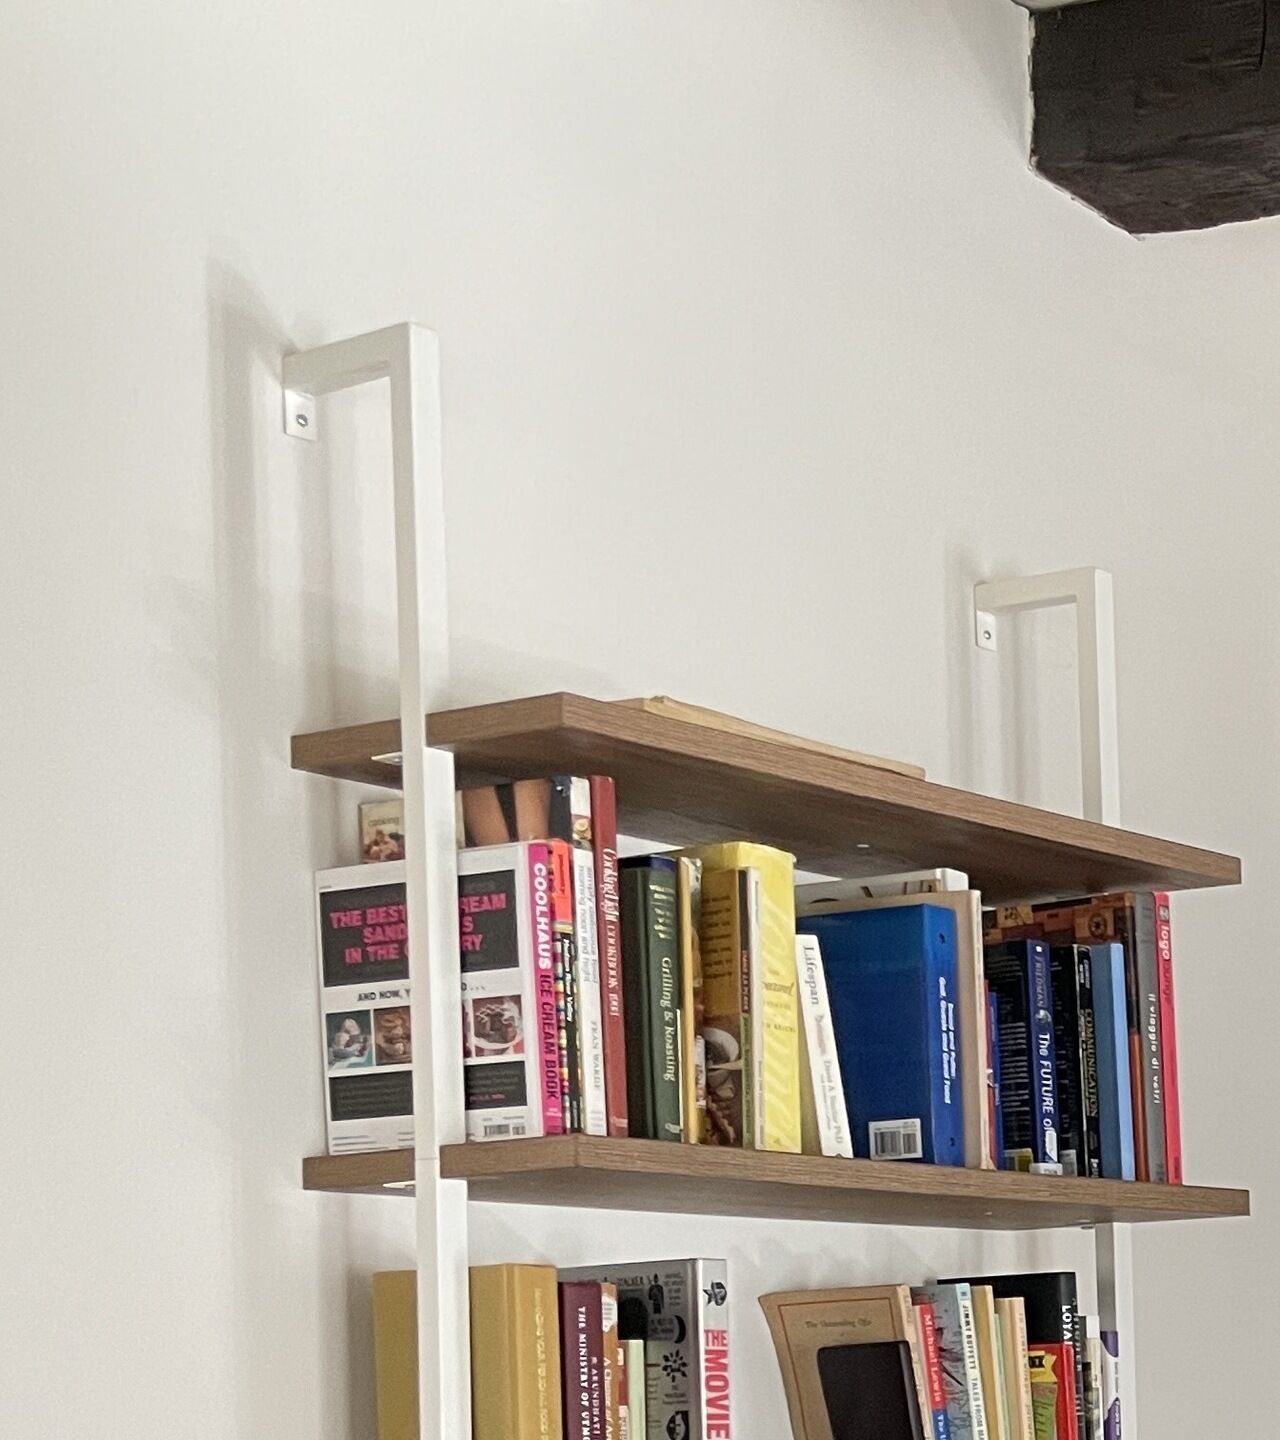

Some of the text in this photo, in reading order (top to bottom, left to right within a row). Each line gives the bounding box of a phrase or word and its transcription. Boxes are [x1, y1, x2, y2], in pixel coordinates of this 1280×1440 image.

[330, 911, 362, 928] THE
[345, 943, 399, 964] IN THE
[581, 936, 590, 955] and
[1159, 924, 1171, 960] logo
[533, 863, 559, 1100] COOLHAUS ICE CREAM BOOK
[803, 946, 821, 1005] Lifespan
[357, 991, 376, 1001] AND
[564, 997, 574, 1022] Valley
[660, 957, 677, 1081] Grilling & Roasting
[1148, 1006, 1157, 1052] viaggio
[1039, 1033, 1051, 1055] The
[1085, 1008, 1098, 1118] COMMUNICATION
[1040, 1060, 1053, 1114] FUTURE
[1042, 1118, 1053, 1131] of
[578, 1306, 587, 1329] THE
[704, 1329, 728, 1347] THE
[924, 1313, 939, 1363] Michael
[578, 1333, 589, 1388] MINISTRY
[963, 1334, 975, 1370] BUFFETT
[581, 1393, 590, 1406] OF
[591, 1368, 600, 1435] ARUNDHATI
[969, 1377, 981, 1402] TALES
[974, 1404, 985, 1428] FROM
